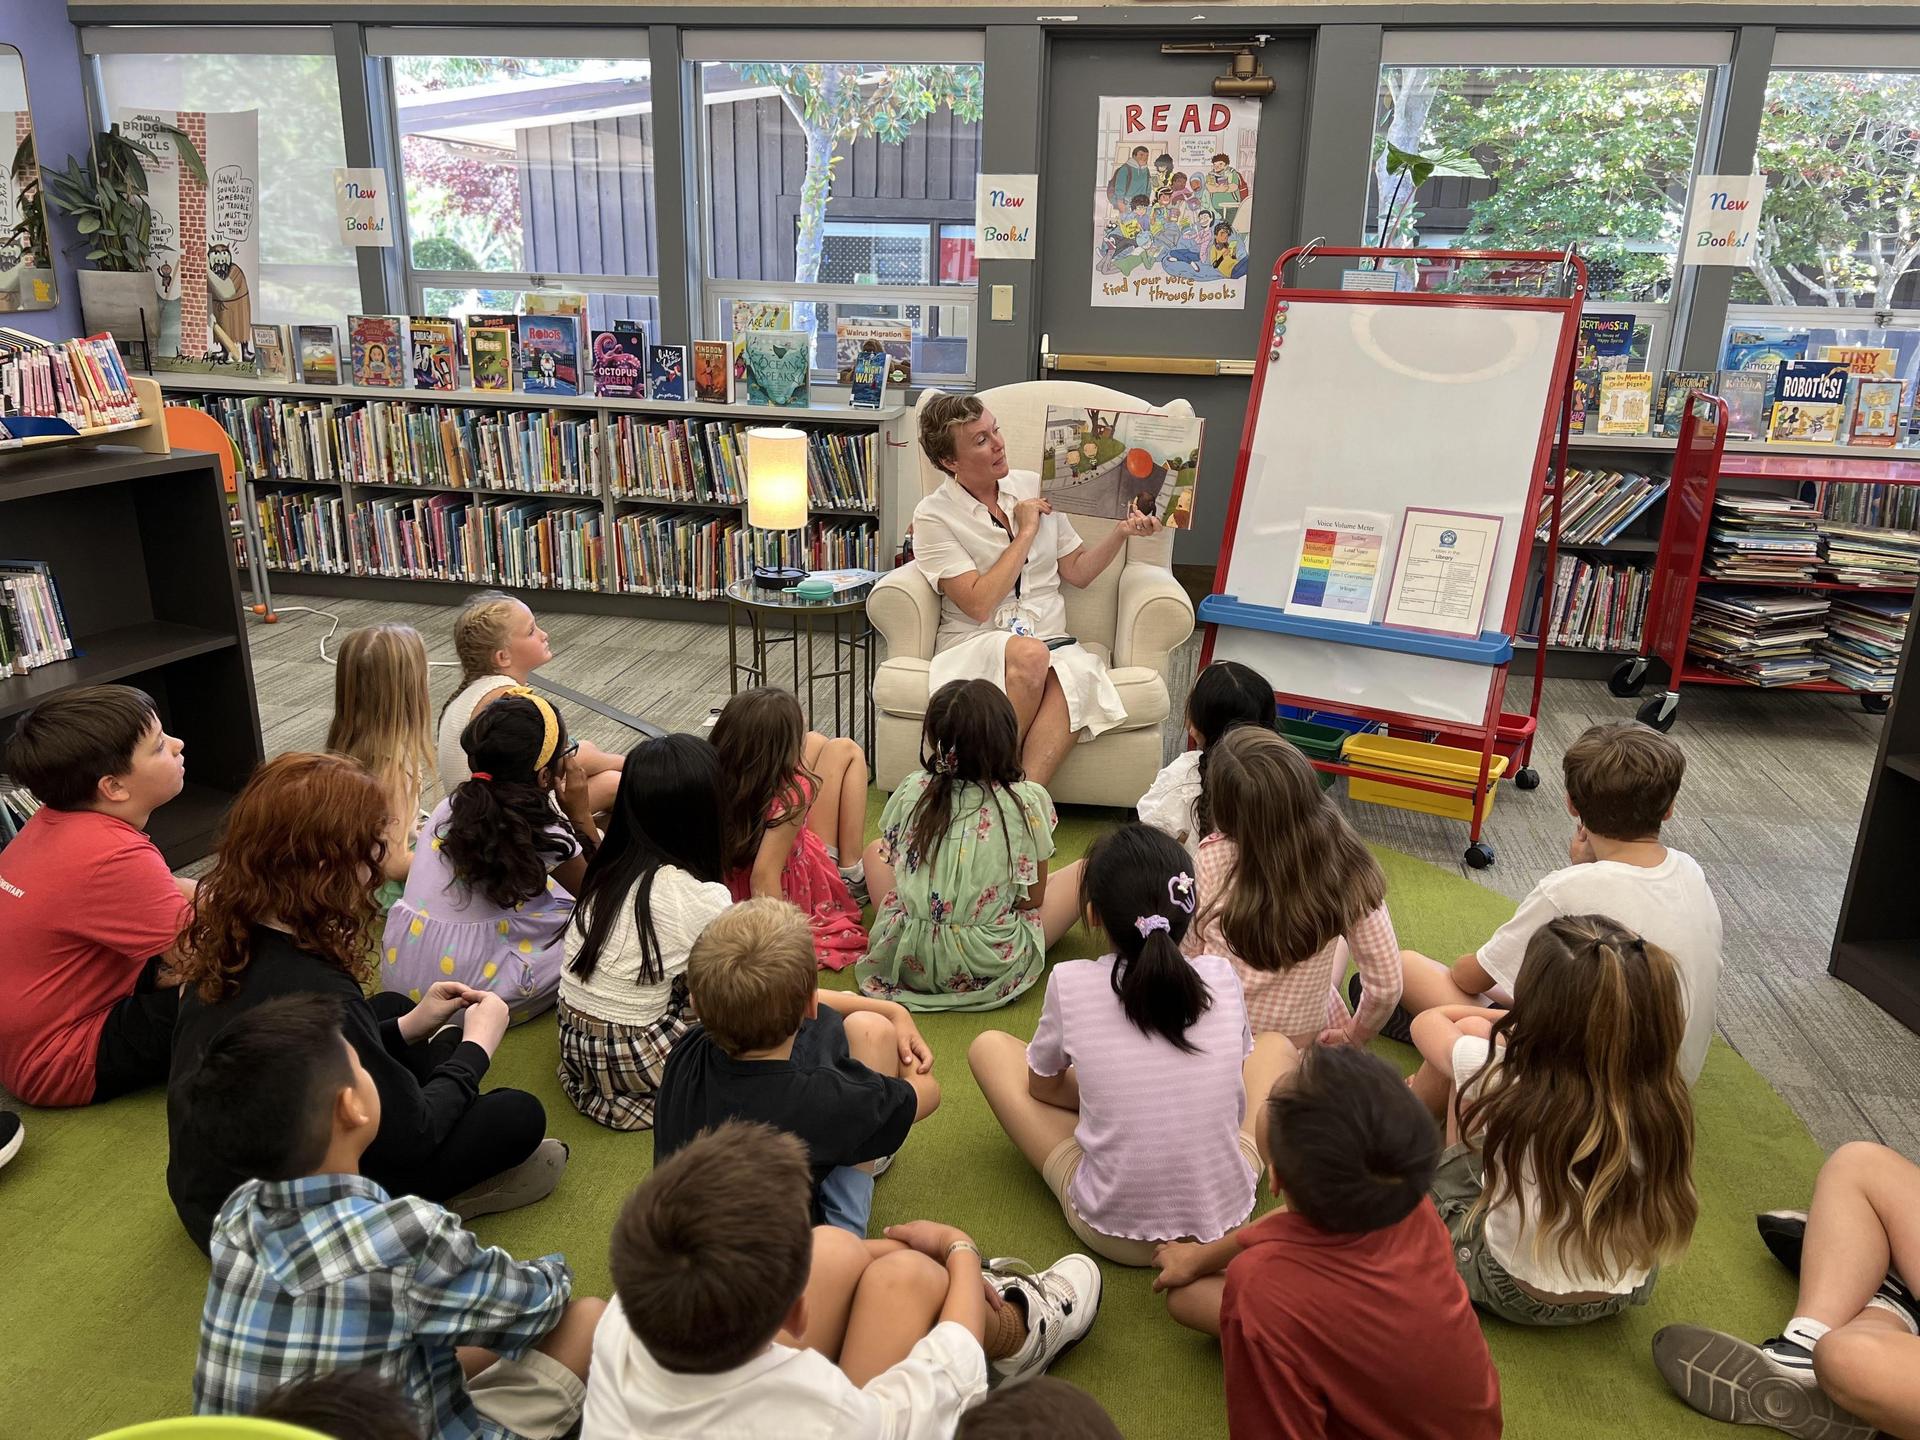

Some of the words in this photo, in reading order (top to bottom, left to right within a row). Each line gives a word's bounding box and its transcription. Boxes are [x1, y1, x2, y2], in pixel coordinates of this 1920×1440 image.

[1126, 104, 1231, 134] READ
[345, 183, 376, 198] New
[990, 190, 1024, 207] New
[1710, 192, 1749, 210] New
[345, 216, 384, 230] Books!
[984, 225, 1029, 241] Books!
[1697, 230, 1749, 247] Books!
[1103, 278, 1128, 295] find
[1133, 276, 1161, 296] your
[1166, 276, 1195, 286] voice
[1149, 285, 1195, 304] through
[1200, 284, 1236, 302] books
[748, 319, 762, 328] ARE
[764, 319, 775, 328] WE
[871, 330, 902, 338] Migration
[479, 340, 502, 350] Bees
[759, 355, 796, 370] OCEAN
[1840, 352, 1880, 364] TINY
[599, 368, 638, 377] OCTOPUS
[1851, 364, 1875, 374] REX
[604, 376, 632, 385] OCEAN
[855, 373, 874, 383] WAR
[1334, 521, 1356, 530] Volume
